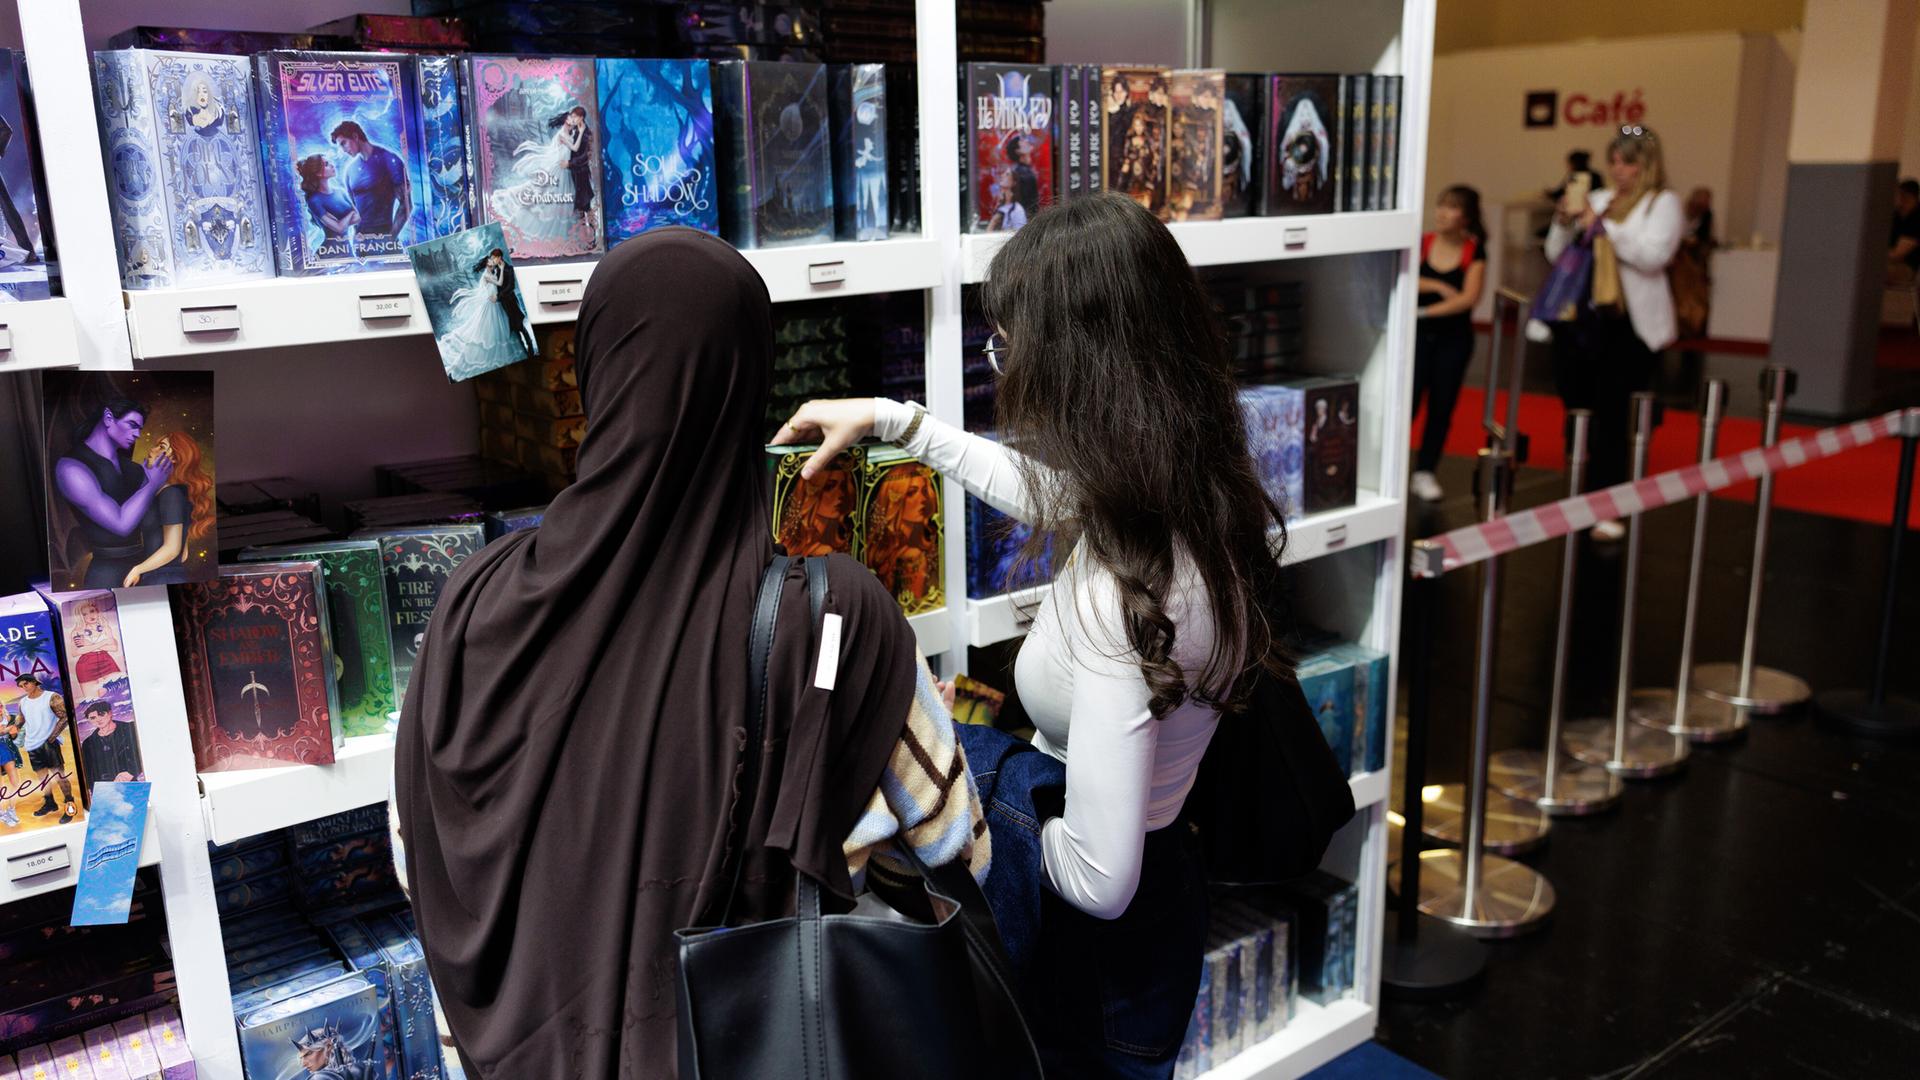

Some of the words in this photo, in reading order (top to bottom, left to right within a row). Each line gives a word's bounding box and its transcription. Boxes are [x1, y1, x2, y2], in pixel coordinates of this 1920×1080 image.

[296, 73, 345, 92] SILVER
[347, 72, 387, 92] ELITE
[1564, 88, 1646, 125] Café
[530, 168, 560, 188] Die
[621, 180, 709, 216] SHADOW
[319, 245, 350, 255] DANI
[353, 240, 404, 253] FRANCIS
[398, 581, 436, 595] FIRE
[401, 598, 412, 608] IN
[414, 598, 435, 607] THE
